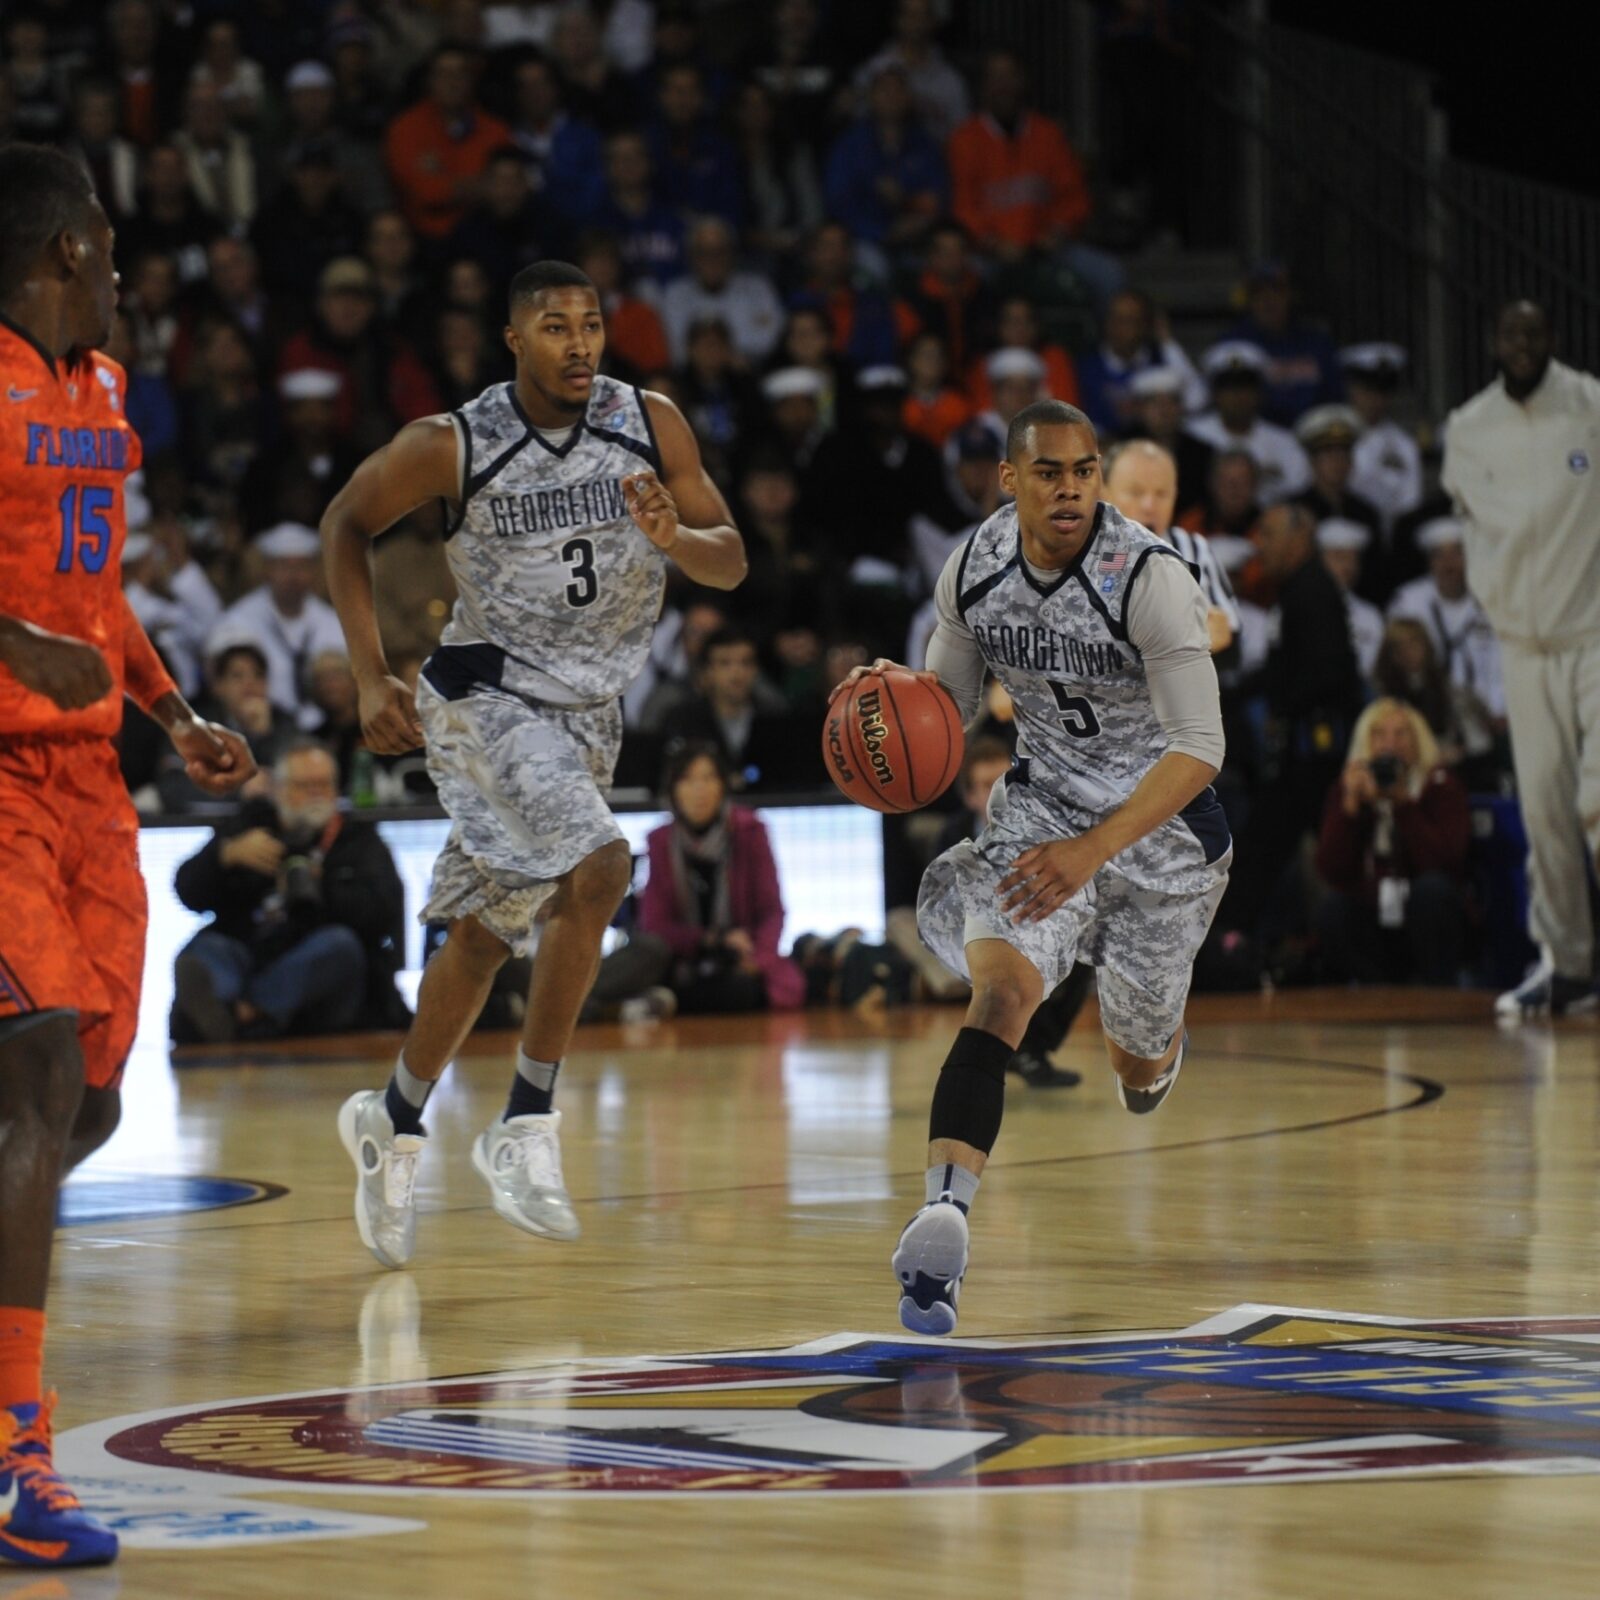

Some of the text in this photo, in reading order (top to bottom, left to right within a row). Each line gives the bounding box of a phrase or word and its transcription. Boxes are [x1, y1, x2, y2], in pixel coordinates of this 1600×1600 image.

[25, 422, 129, 471] FLORID
[56, 484, 113, 574] 15
[489, 476, 628, 538] GEORGETOW
[560, 537, 599, 610] 3
[973, 624, 1124, 677] GEORGETOWN
[856, 687, 896, 787] Wilson
[1044, 679, 1102, 739] 5
[828, 716, 855, 784] NCAA
[1023, 1347, 1600, 1418] CLASS
